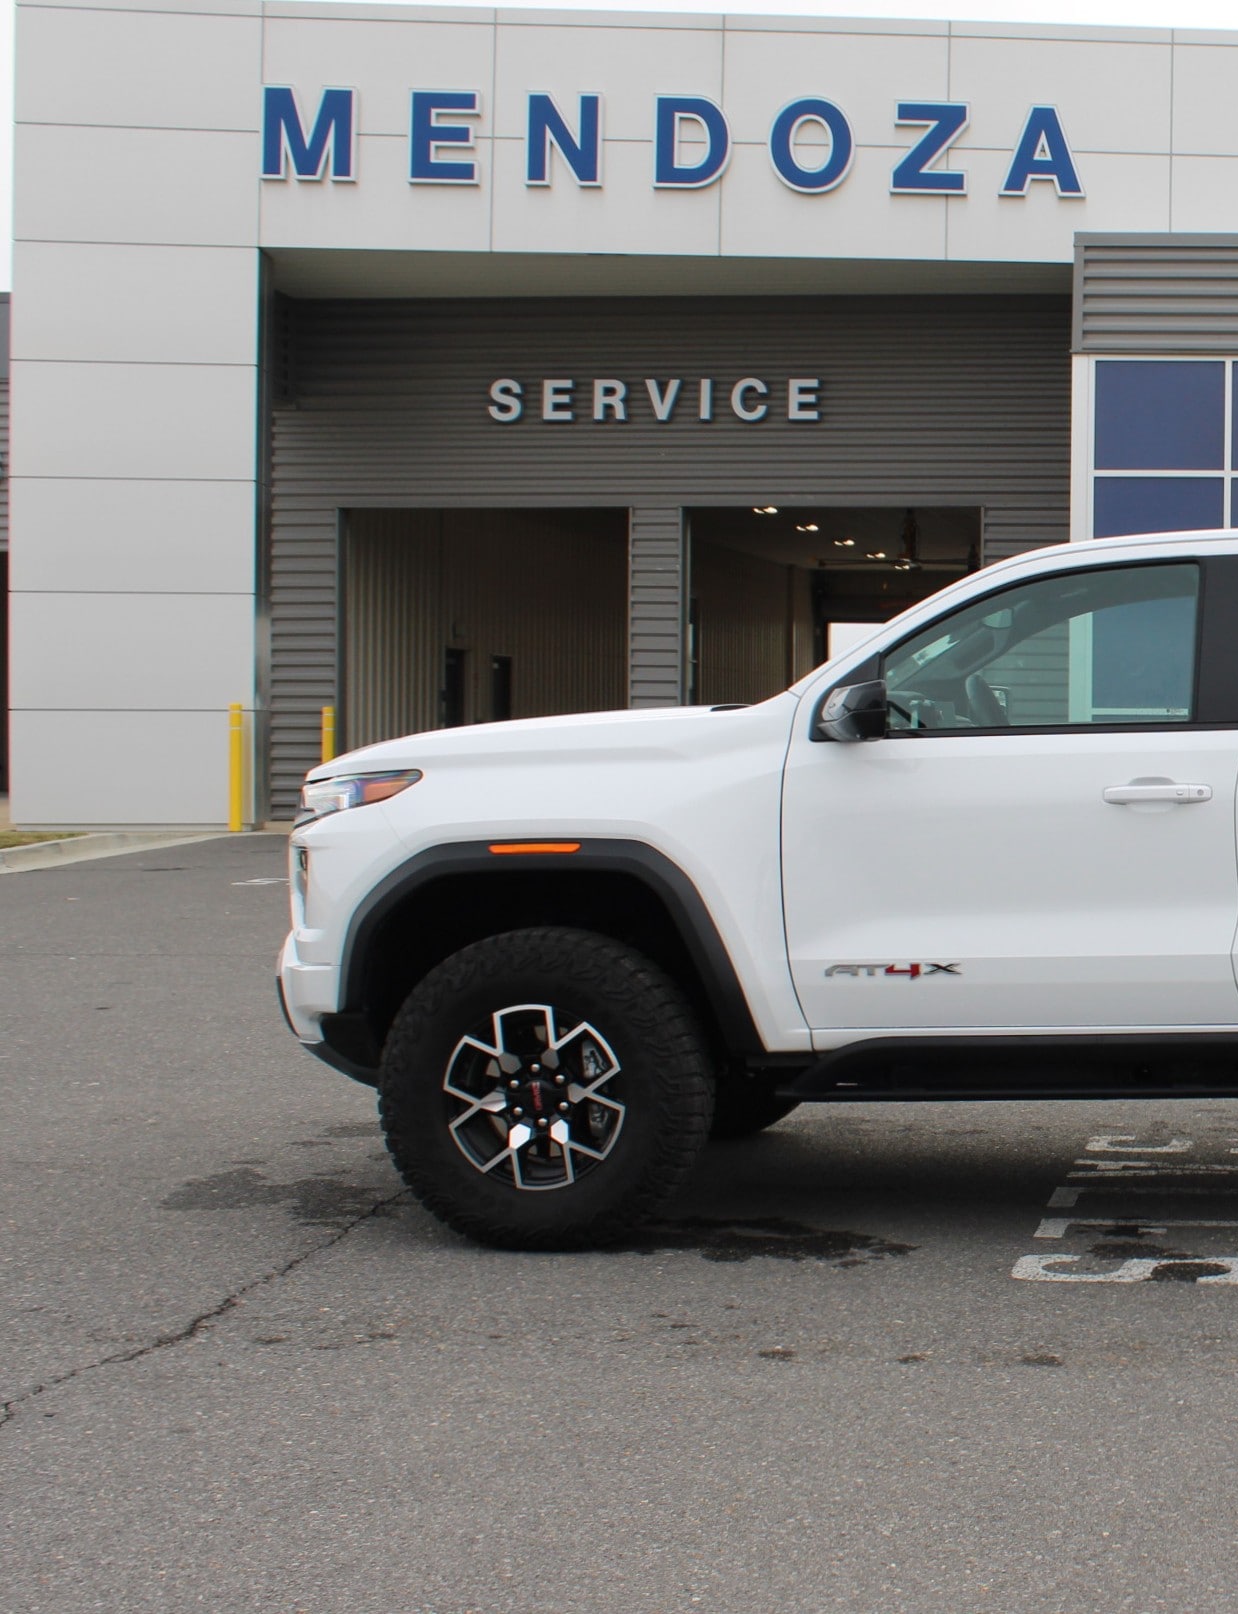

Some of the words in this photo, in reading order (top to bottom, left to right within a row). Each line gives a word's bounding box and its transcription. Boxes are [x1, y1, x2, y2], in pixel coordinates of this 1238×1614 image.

[261, 84, 1085, 199] MENDOZA
[488, 377, 821, 421] SERVICE
[824, 963, 963, 980] AT4X
